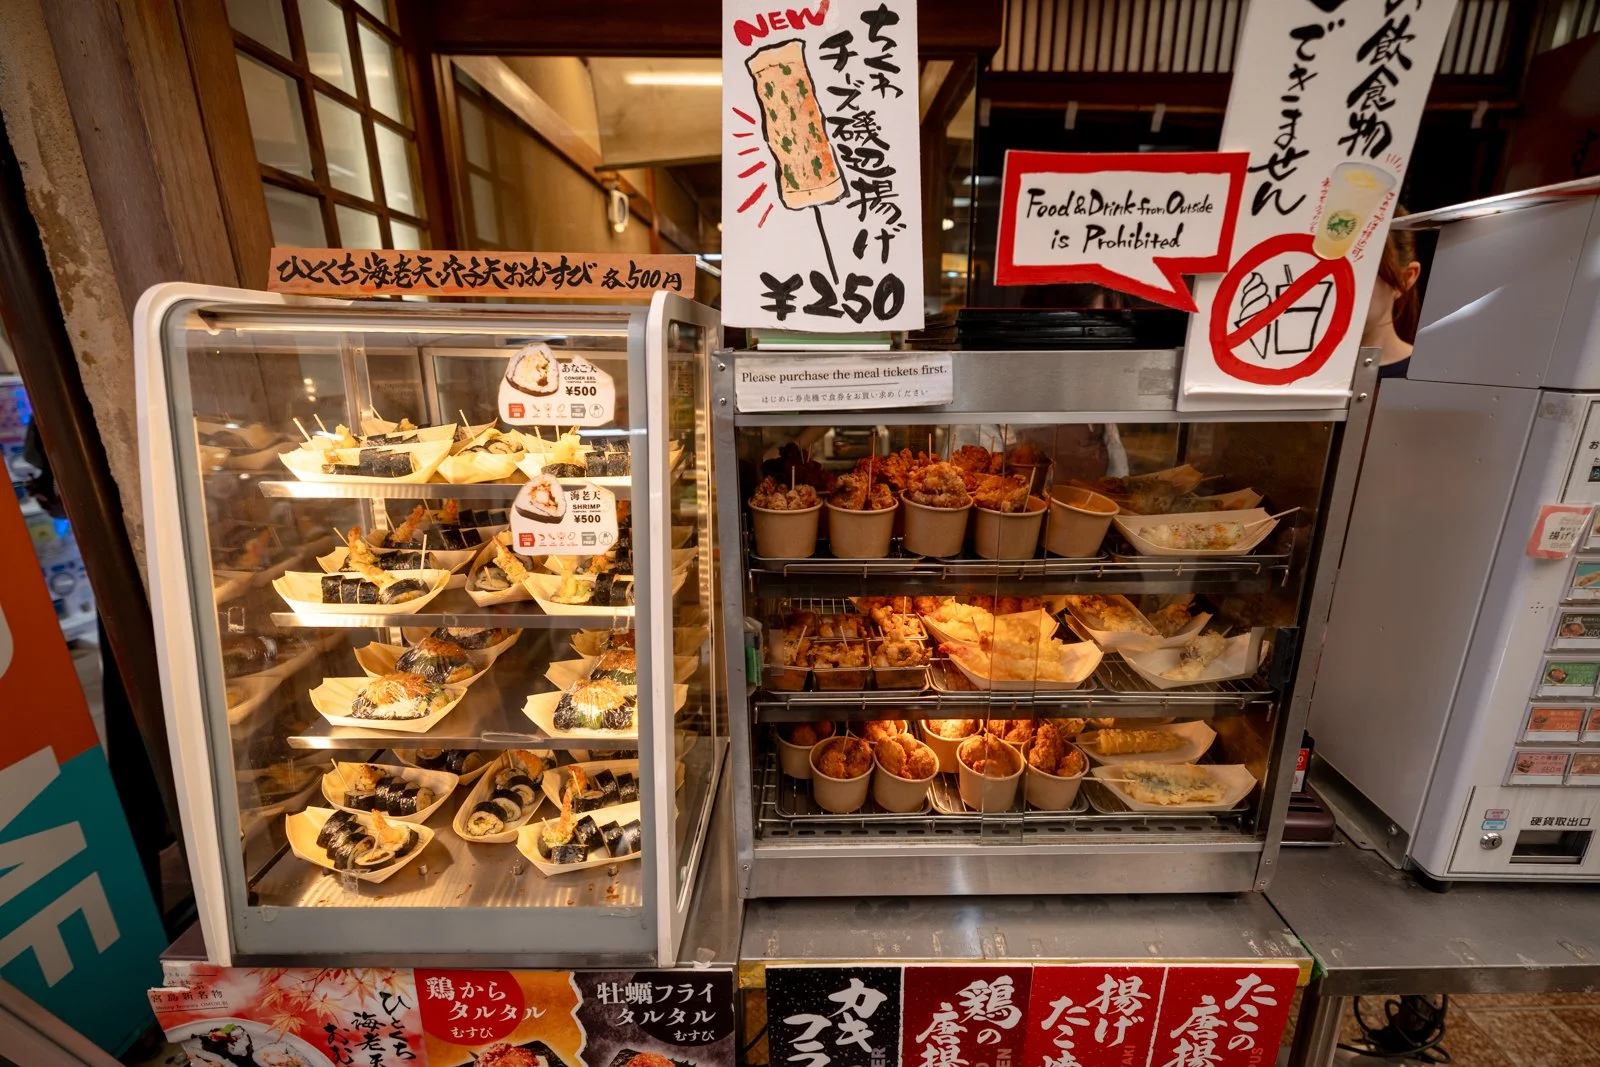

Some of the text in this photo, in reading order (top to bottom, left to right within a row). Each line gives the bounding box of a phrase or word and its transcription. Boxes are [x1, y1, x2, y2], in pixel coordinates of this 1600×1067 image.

[733, 0, 831, 47] NEW
[860, 3, 904, 99] ちくわ
[1026, 188, 1076, 218] Food
[1087, 188, 1137, 216] Drink
[1165, 190, 1214, 215] Outside
[1050, 221, 1185, 253] is Prohibited
[600, 259, 683, 292] 各500円
[760, 271, 906, 324] ¥250
[741, 364, 947, 385] Please purchase the meal tickets first.
[565, 386, 597, 396] ¥500
[570, 490, 601, 501] 海老天
[573, 514, 601, 523] ¥500
[1530, 816, 1592, 827] 硬貨取出口
[425, 976, 507, 1002] 鶏から
[447, 1001, 548, 1022] タルタル
[615, 1009, 718, 1027] タルタル
[827, 977, 888, 1053] カキ
[955, 975, 1023, 1045] 鶏の
[1085, 973, 1152, 1048] 揚げ
[1225, 973, 1278, 1051] たこの
[379, 991, 417, 1061] ひとくち
[450, 1026, 494, 1040] むすび
[673, 1029, 717, 1042] むすび
